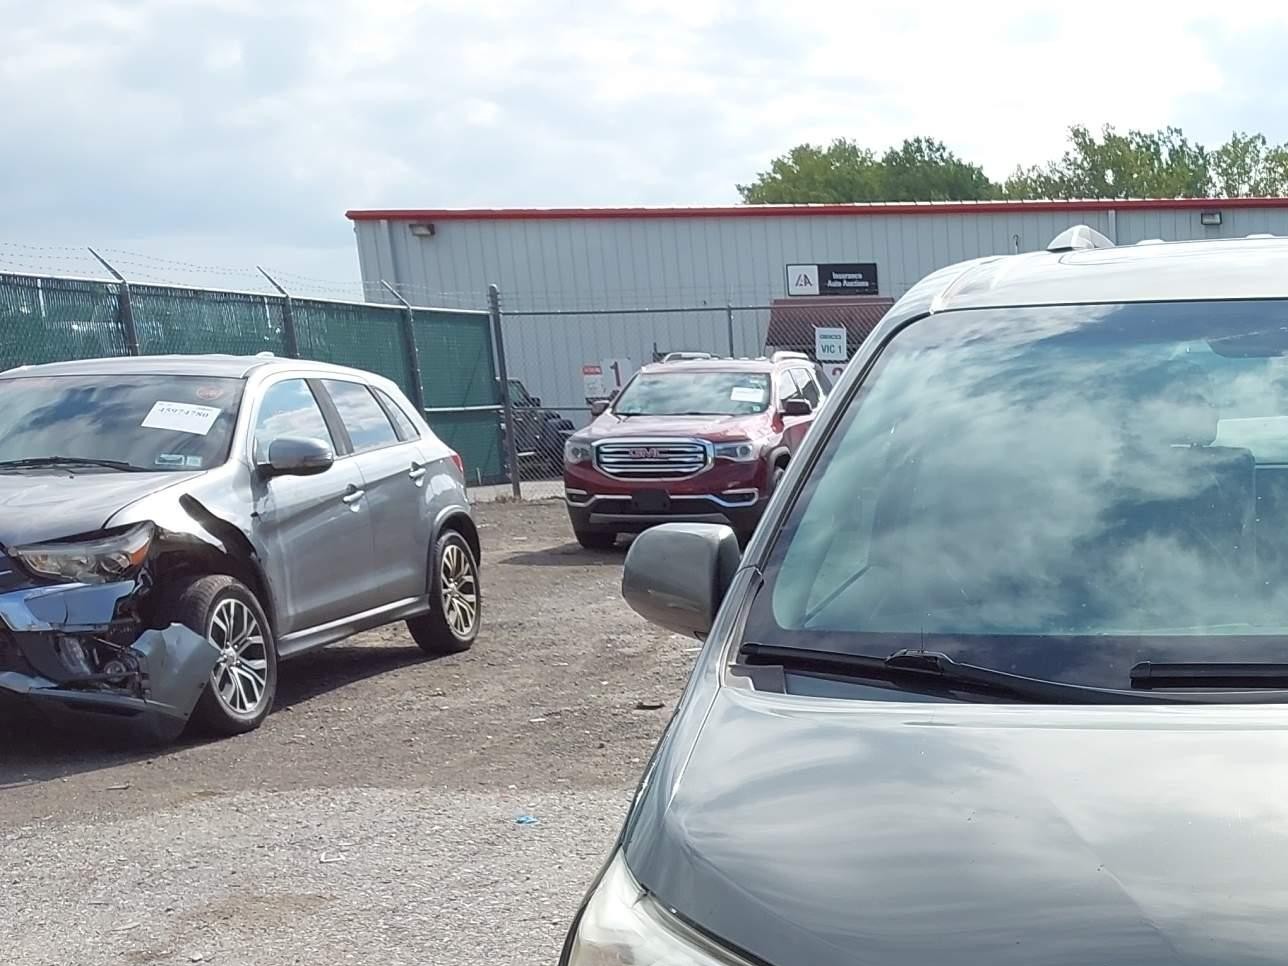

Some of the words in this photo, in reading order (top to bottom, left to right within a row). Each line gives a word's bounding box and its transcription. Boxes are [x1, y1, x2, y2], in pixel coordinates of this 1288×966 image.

[821, 344, 835, 354] VIC
[838, 344, 842, 354] 1
[610, 361, 620, 386] 1
